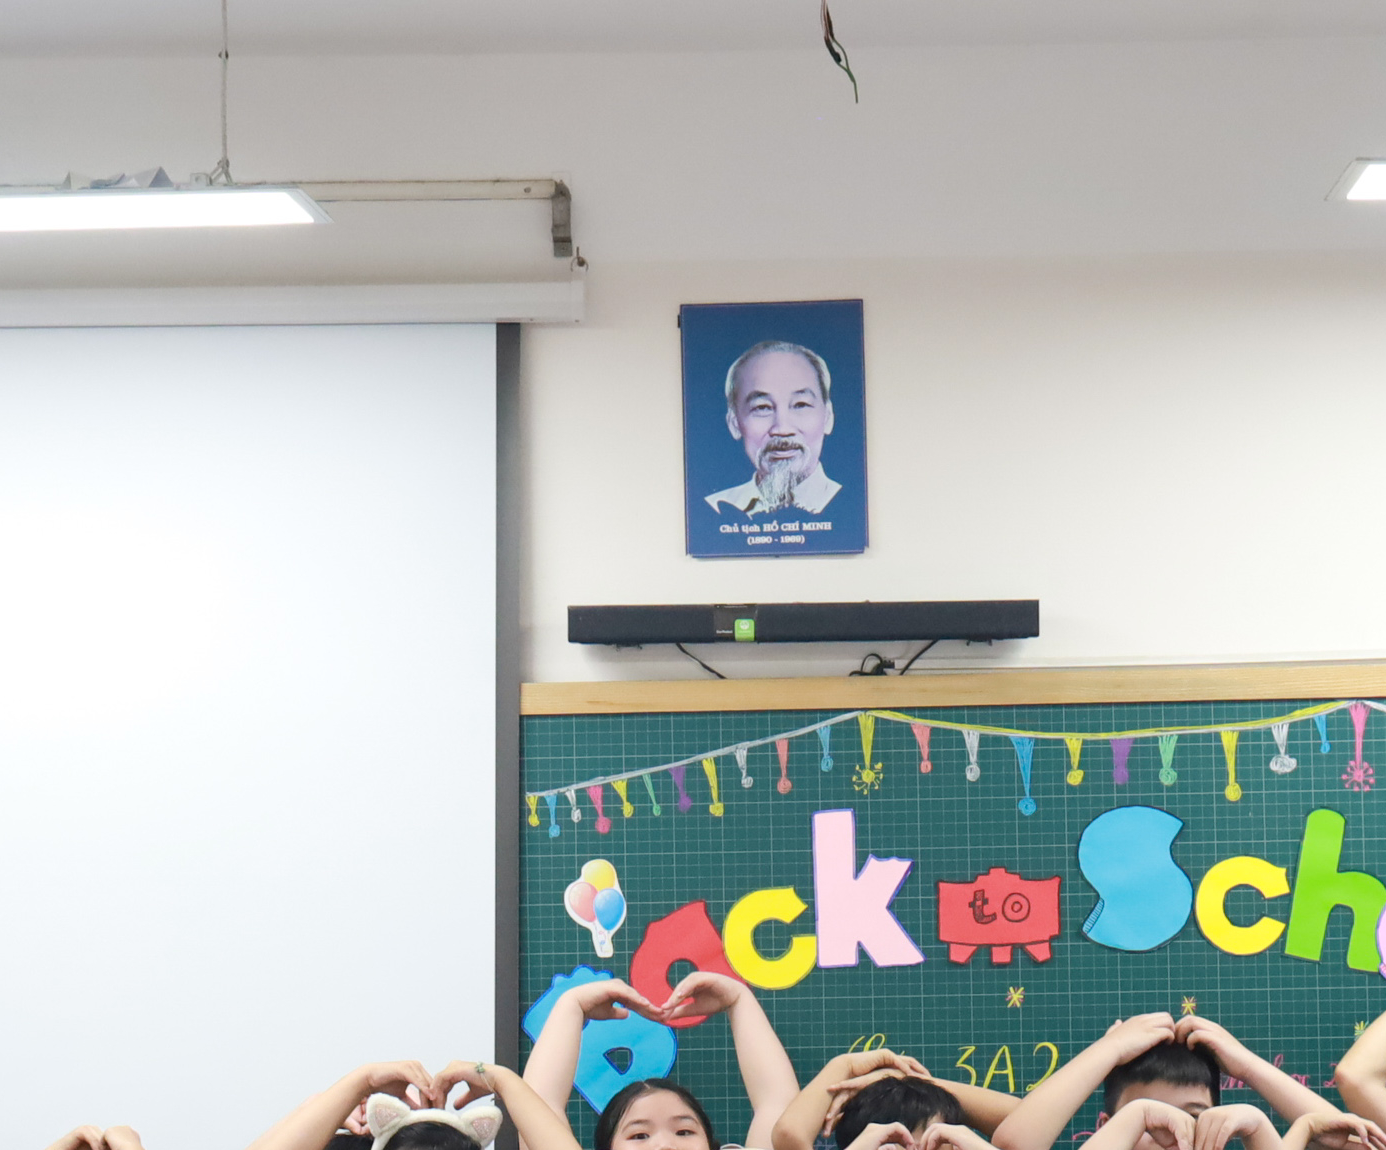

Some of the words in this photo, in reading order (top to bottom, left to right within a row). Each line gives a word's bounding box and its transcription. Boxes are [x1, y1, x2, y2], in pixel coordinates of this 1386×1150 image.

[719, 523, 739, 533] Chủ
[741, 525, 760, 534] tịch
[781, 521, 799, 531] CHÍ
[802, 522, 832, 530] MINH
[968, 890, 1032, 924] to
